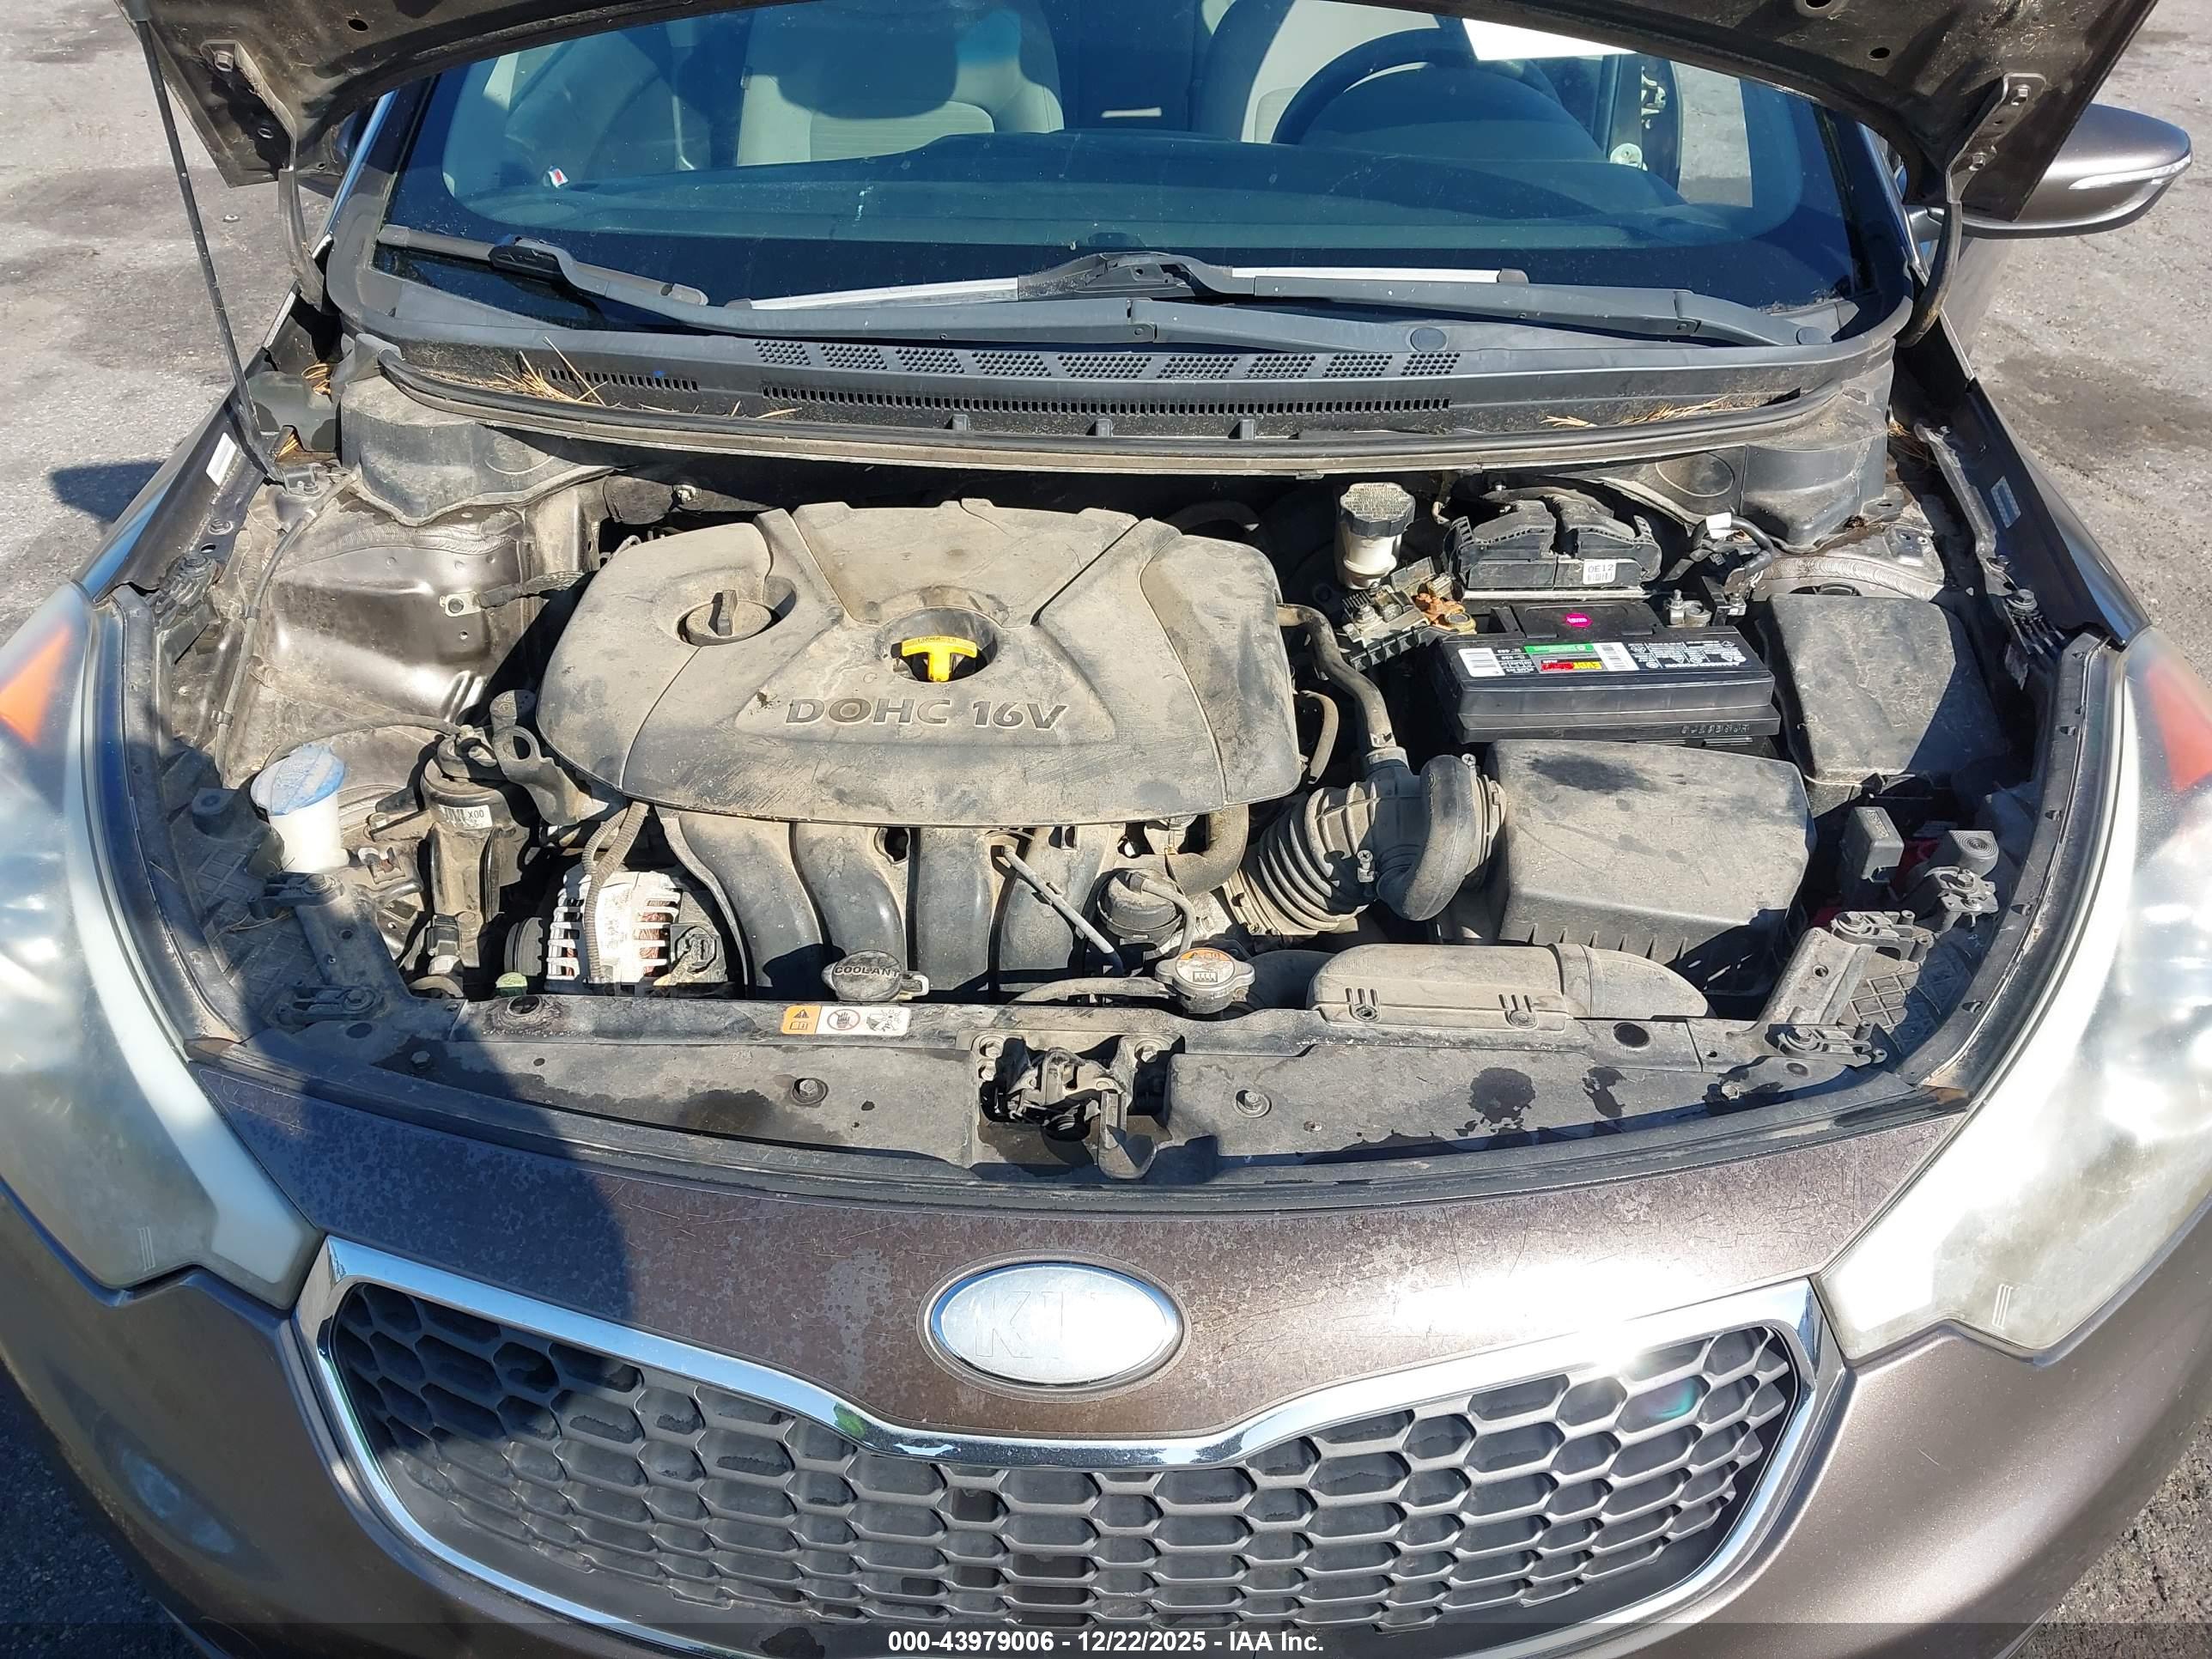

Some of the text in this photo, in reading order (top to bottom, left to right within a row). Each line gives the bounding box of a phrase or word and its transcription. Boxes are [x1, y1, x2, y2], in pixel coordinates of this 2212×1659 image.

[786, 697, 1068, 730] DOHC 16V
[835, 966, 901, 979] COOLANT
